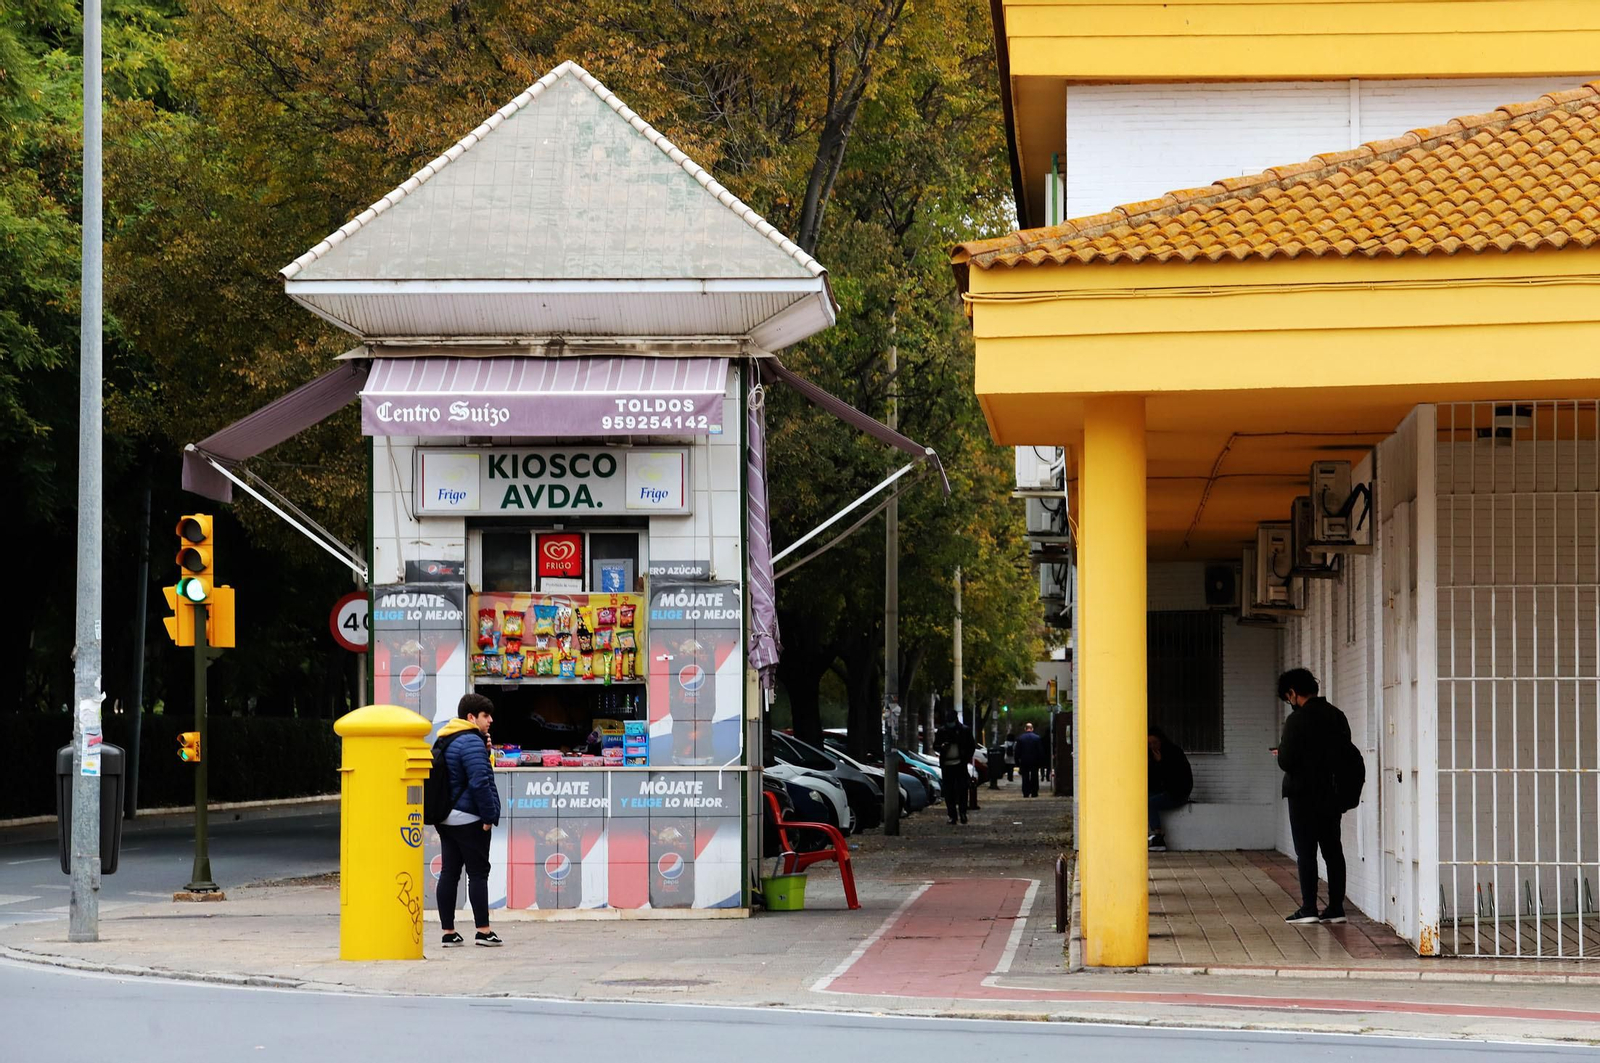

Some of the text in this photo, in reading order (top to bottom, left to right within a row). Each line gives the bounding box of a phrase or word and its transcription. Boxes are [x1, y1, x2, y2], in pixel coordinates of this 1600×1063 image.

[615, 399, 695, 413] TOLDOS
[376, 401, 510, 427] Centro Suizo
[602, 416, 708, 430] 959254142
[488, 453, 617, 479] KIOSCO
[438, 488, 467, 505] Frigo
[500, 484, 603, 509] AVDA.
[640, 487, 669, 504] Frigo
[546, 561, 572, 570] FRIGO
[667, 564, 703, 575] AZÚCAR
[660, 588, 724, 607] MÓJATE
[374, 609, 463, 621] ELIGE LO MEJOR
[651, 609, 741, 620] ELIGE LO MEJOR
[525, 776, 590, 796] MÓJATE
[639, 776, 704, 795] MÓJATE
[507, 798, 609, 809] Y ELIGE LO MEJOR
[620, 797, 723, 808] Y ELIGE LO MEJOR
